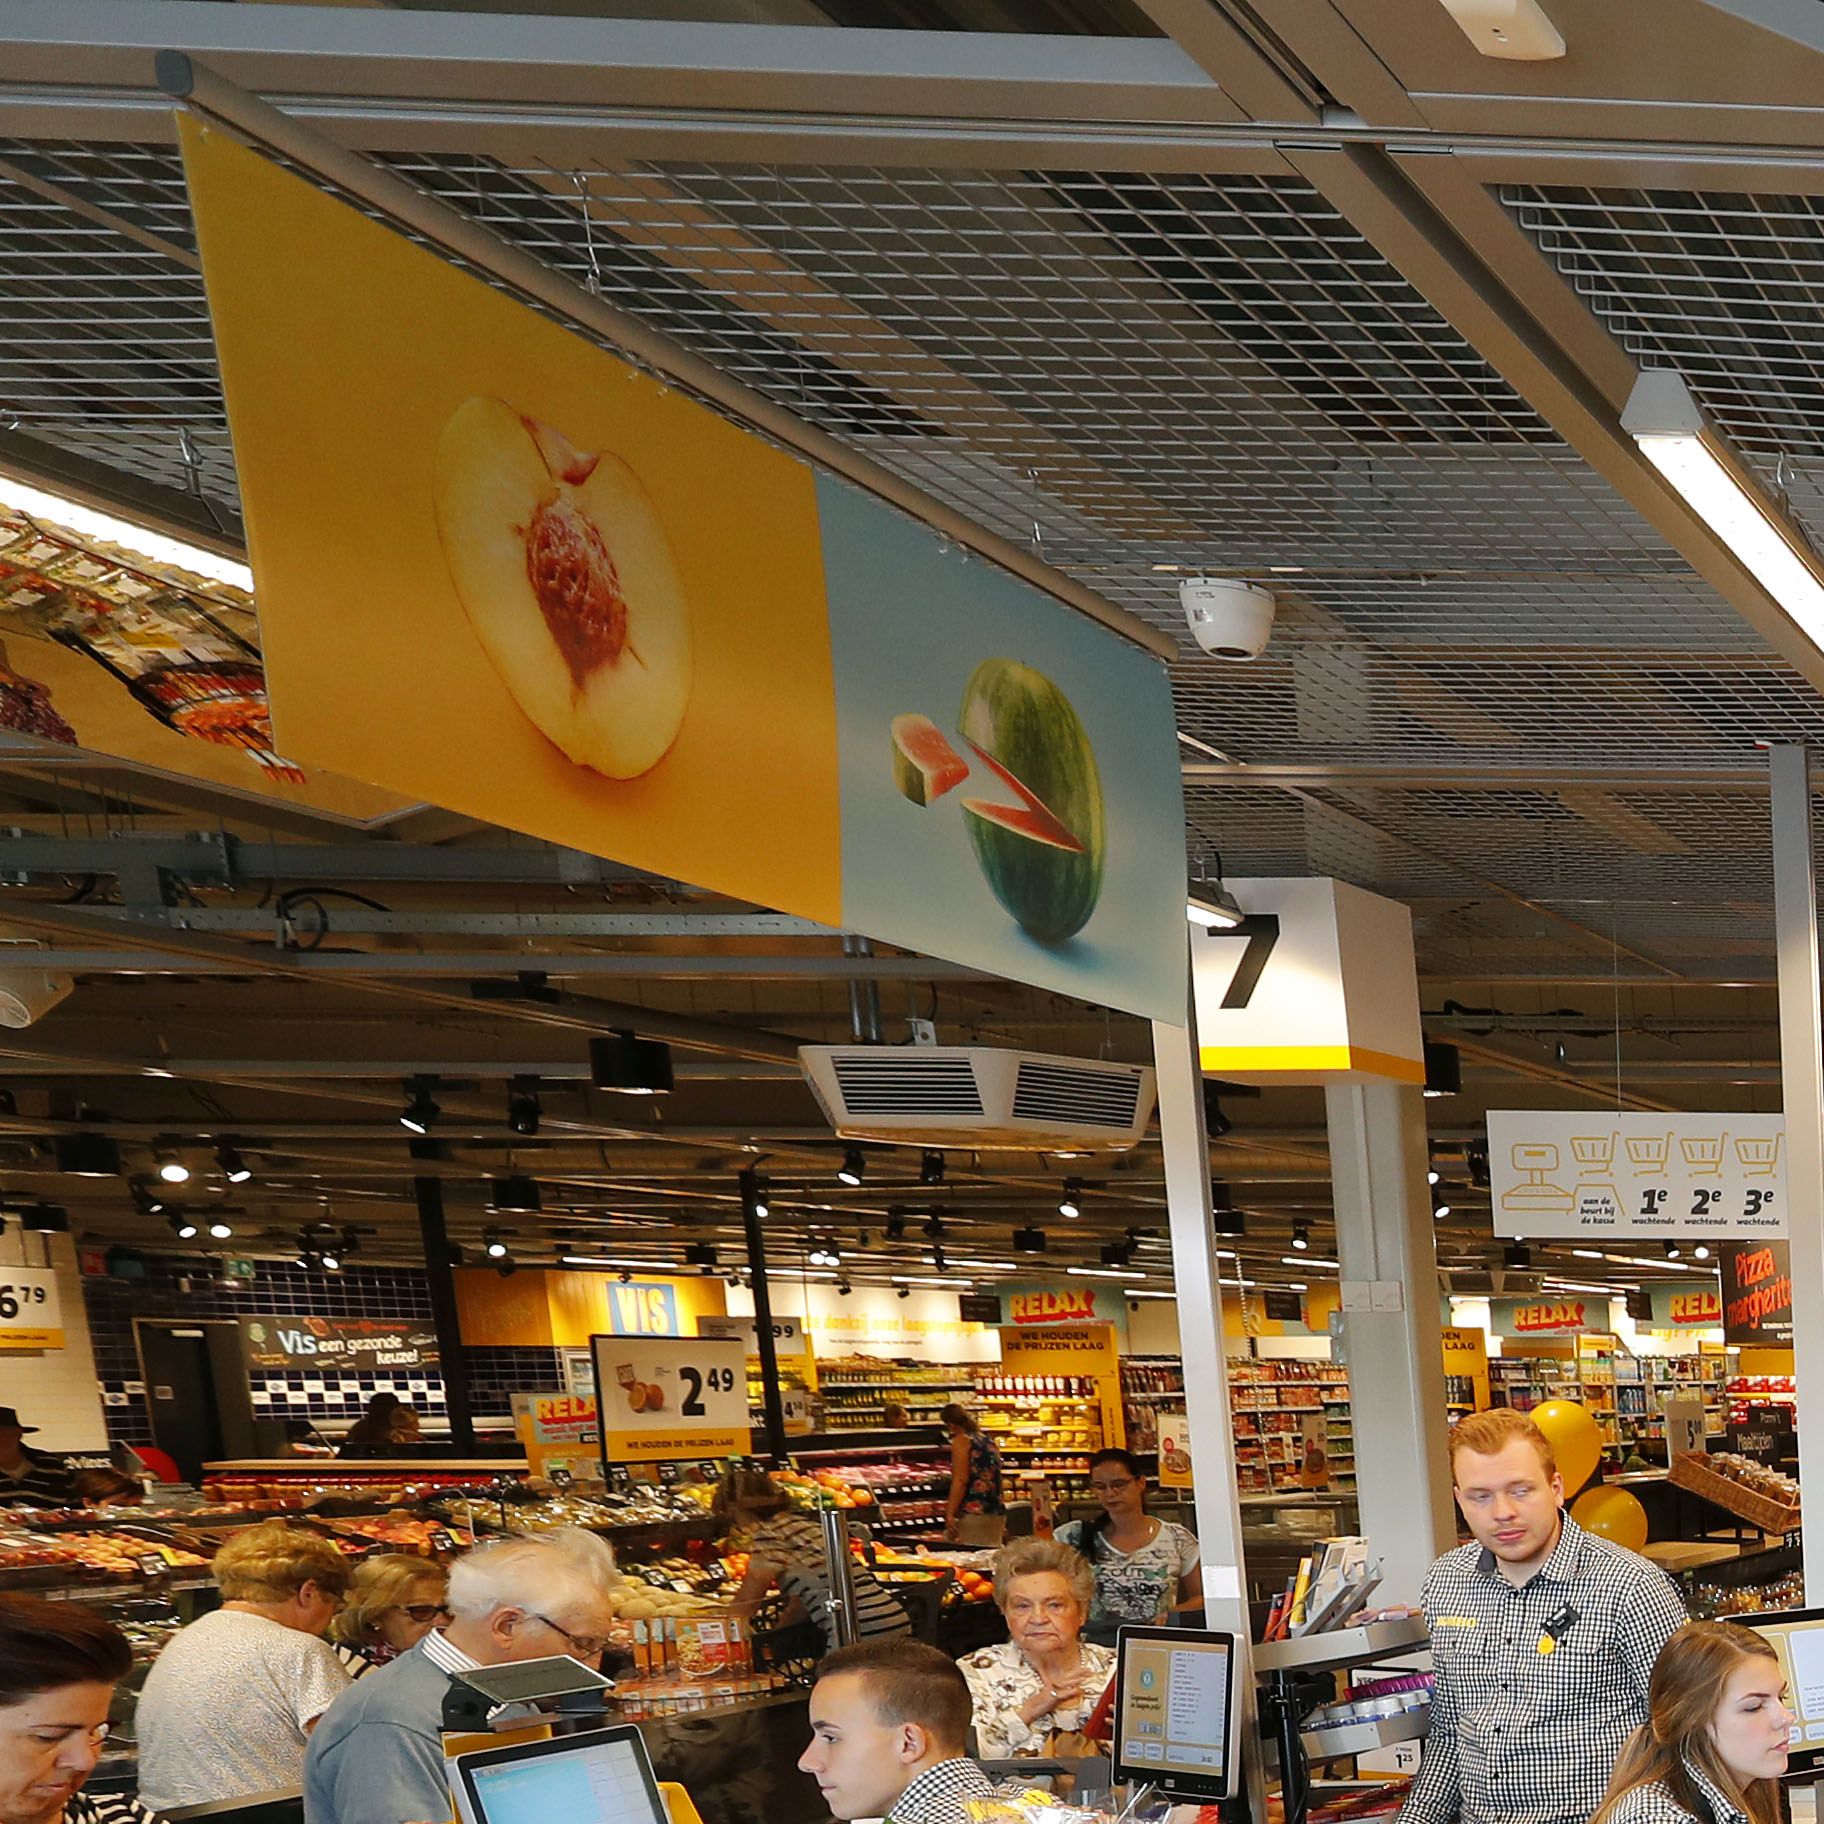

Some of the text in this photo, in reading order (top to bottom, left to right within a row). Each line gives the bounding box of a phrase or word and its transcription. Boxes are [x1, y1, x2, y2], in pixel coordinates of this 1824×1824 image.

[1207, 914, 1280, 1009] 7
[1640, 1189, 1668, 1215] 1e
[1691, 1189, 1722, 1215] 2e
[1743, 1190, 1774, 1216] 3e
[1735, 1248, 1775, 1286] Pizza
[615, 1286, 669, 1335] VIS
[1010, 1289, 1095, 1324] RELAX
[1513, 1301, 1585, 1332] RELAX
[276, 1330, 402, 1354] Vis een gezonde
[1007, 1342, 1104, 1351] DE PRIJZEN LAAG
[1020, 1331, 1089, 1341] WE HOUDEN
[376, 1350, 419, 1365] keuze!
[641, 1440, 671, 1449] HOUDEN
